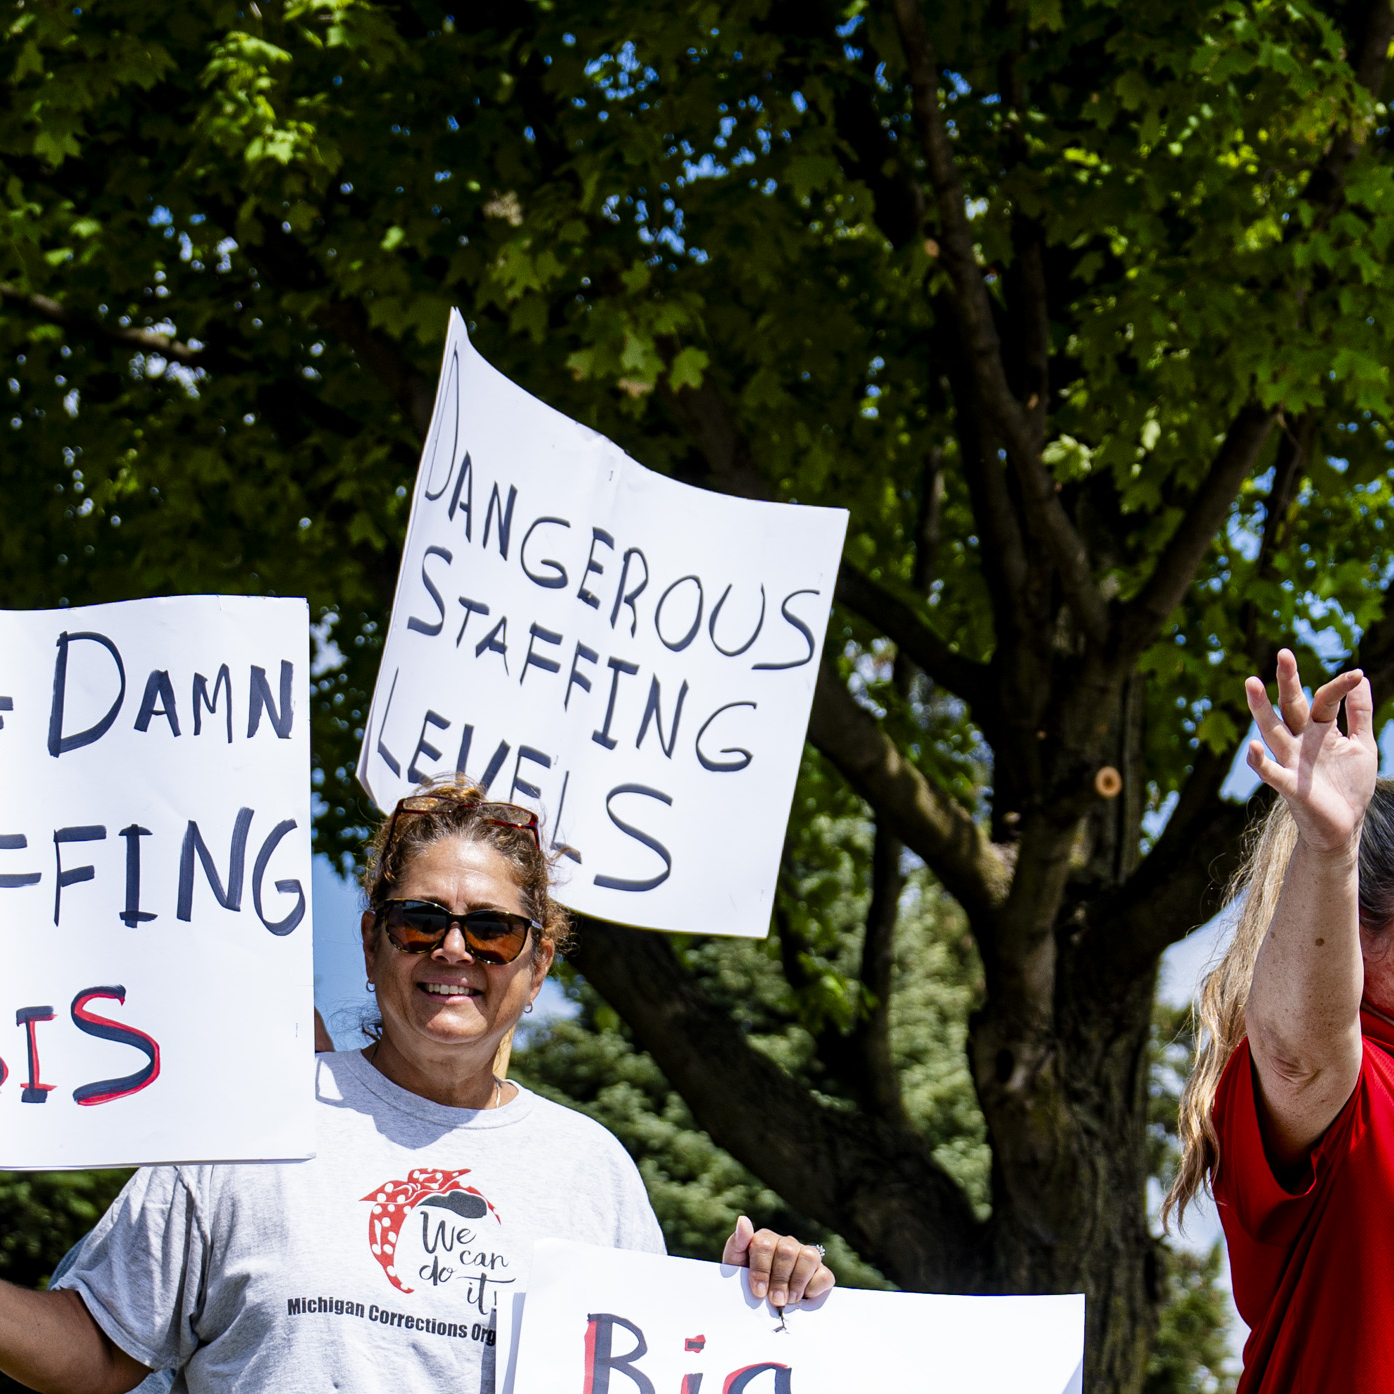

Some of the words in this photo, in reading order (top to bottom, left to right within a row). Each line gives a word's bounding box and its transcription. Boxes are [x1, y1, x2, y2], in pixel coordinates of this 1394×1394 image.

[425, 341, 821, 671] DANGEROUS
[408, 544, 758, 772] STAFFING
[48, 630, 294, 758] DAMN
[377, 667, 673, 892] LEVELS
[420, 1210, 476, 1254] We
[419, 1256, 456, 1286] do
[459, 1249, 509, 1270] can
[456, 1273, 516, 1315] it!
[287, 1296, 365, 1319] Michigan
[369, 1304, 468, 1338] Corrections
